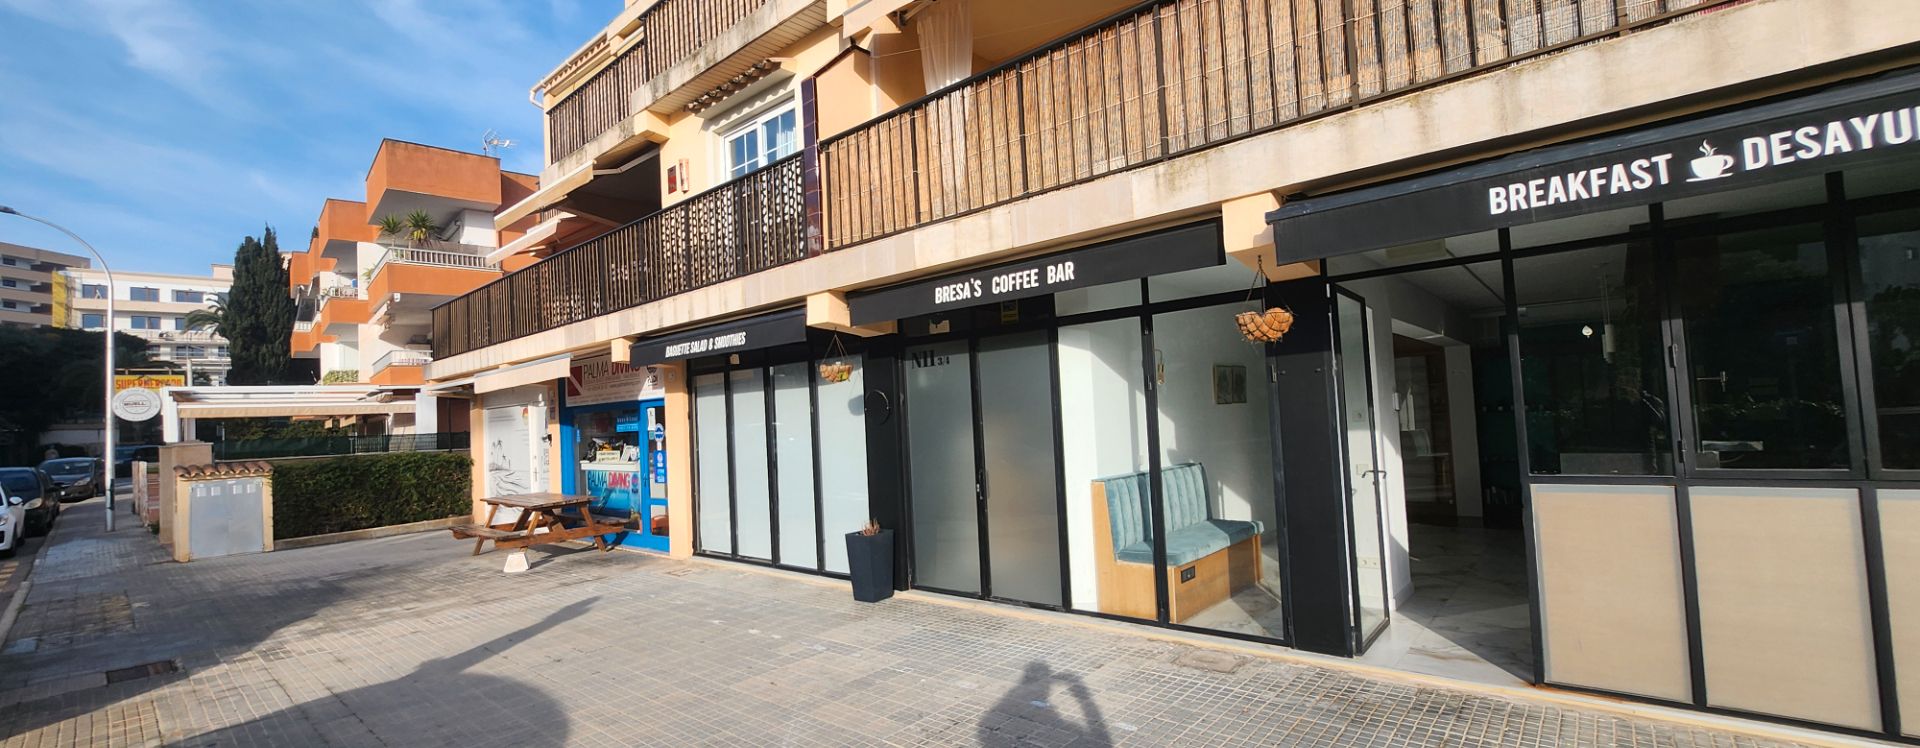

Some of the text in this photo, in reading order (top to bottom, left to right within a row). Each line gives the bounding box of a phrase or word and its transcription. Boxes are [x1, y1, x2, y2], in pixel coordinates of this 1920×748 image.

[1488, 153, 1673, 215] BREAKFAST
[935, 261, 1075, 304] BRESA'S COFFEE BAR
[690, 338, 708, 354] SALAD
[714, 331, 747, 350] SMOOTHIES
[583, 361, 609, 380] PALMA
[588, 470, 630, 488] PALMA DIVING
